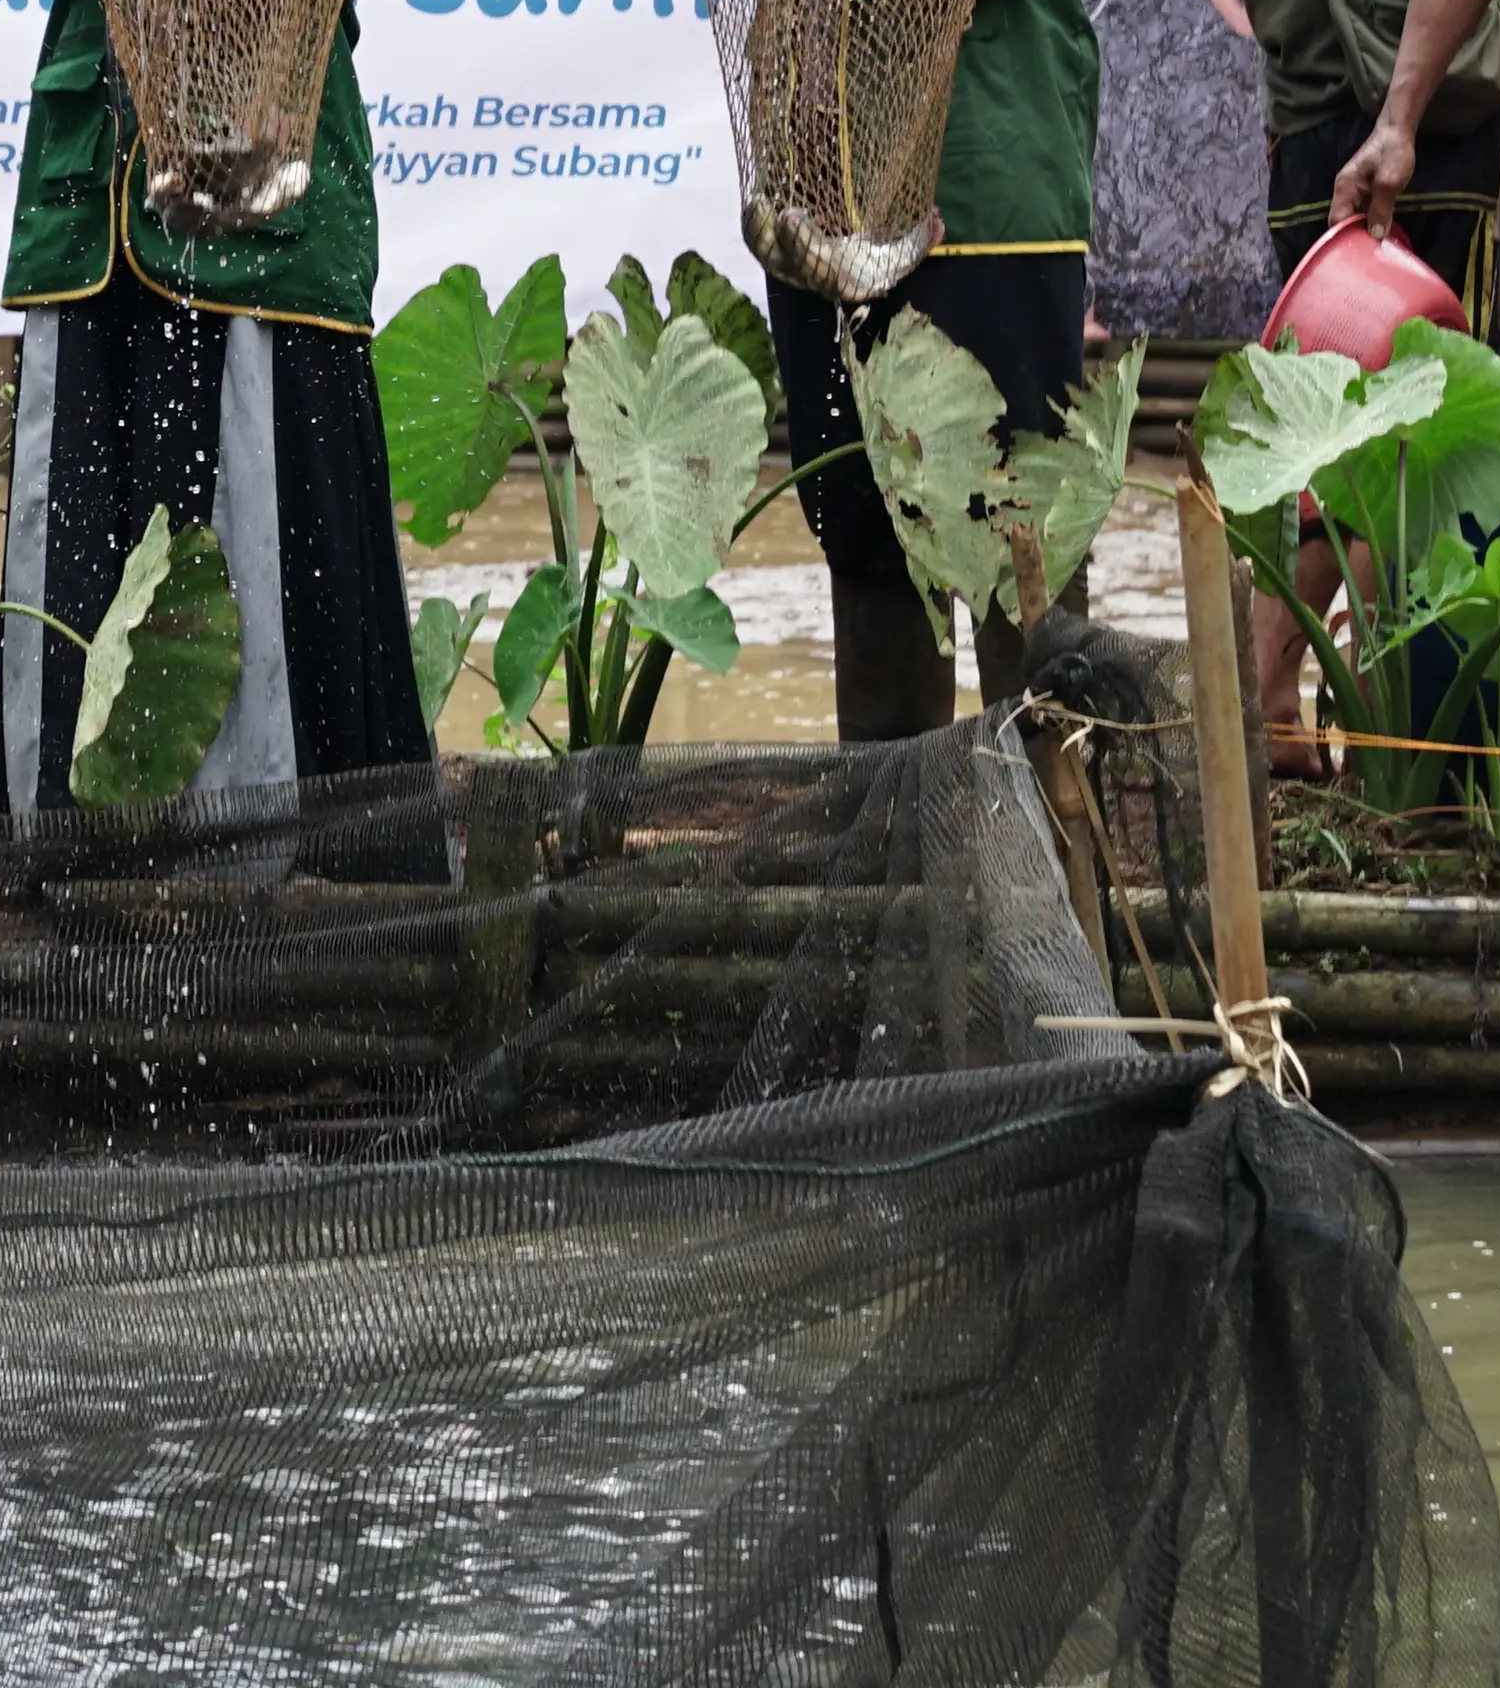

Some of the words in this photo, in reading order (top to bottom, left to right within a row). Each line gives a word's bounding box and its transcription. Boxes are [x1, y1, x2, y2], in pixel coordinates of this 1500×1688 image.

[363, 93, 459, 128] rkah
[473, 96, 668, 129] Bersama
[372, 141, 498, 185] iyyan
[511, 144, 703, 185] Subang"
